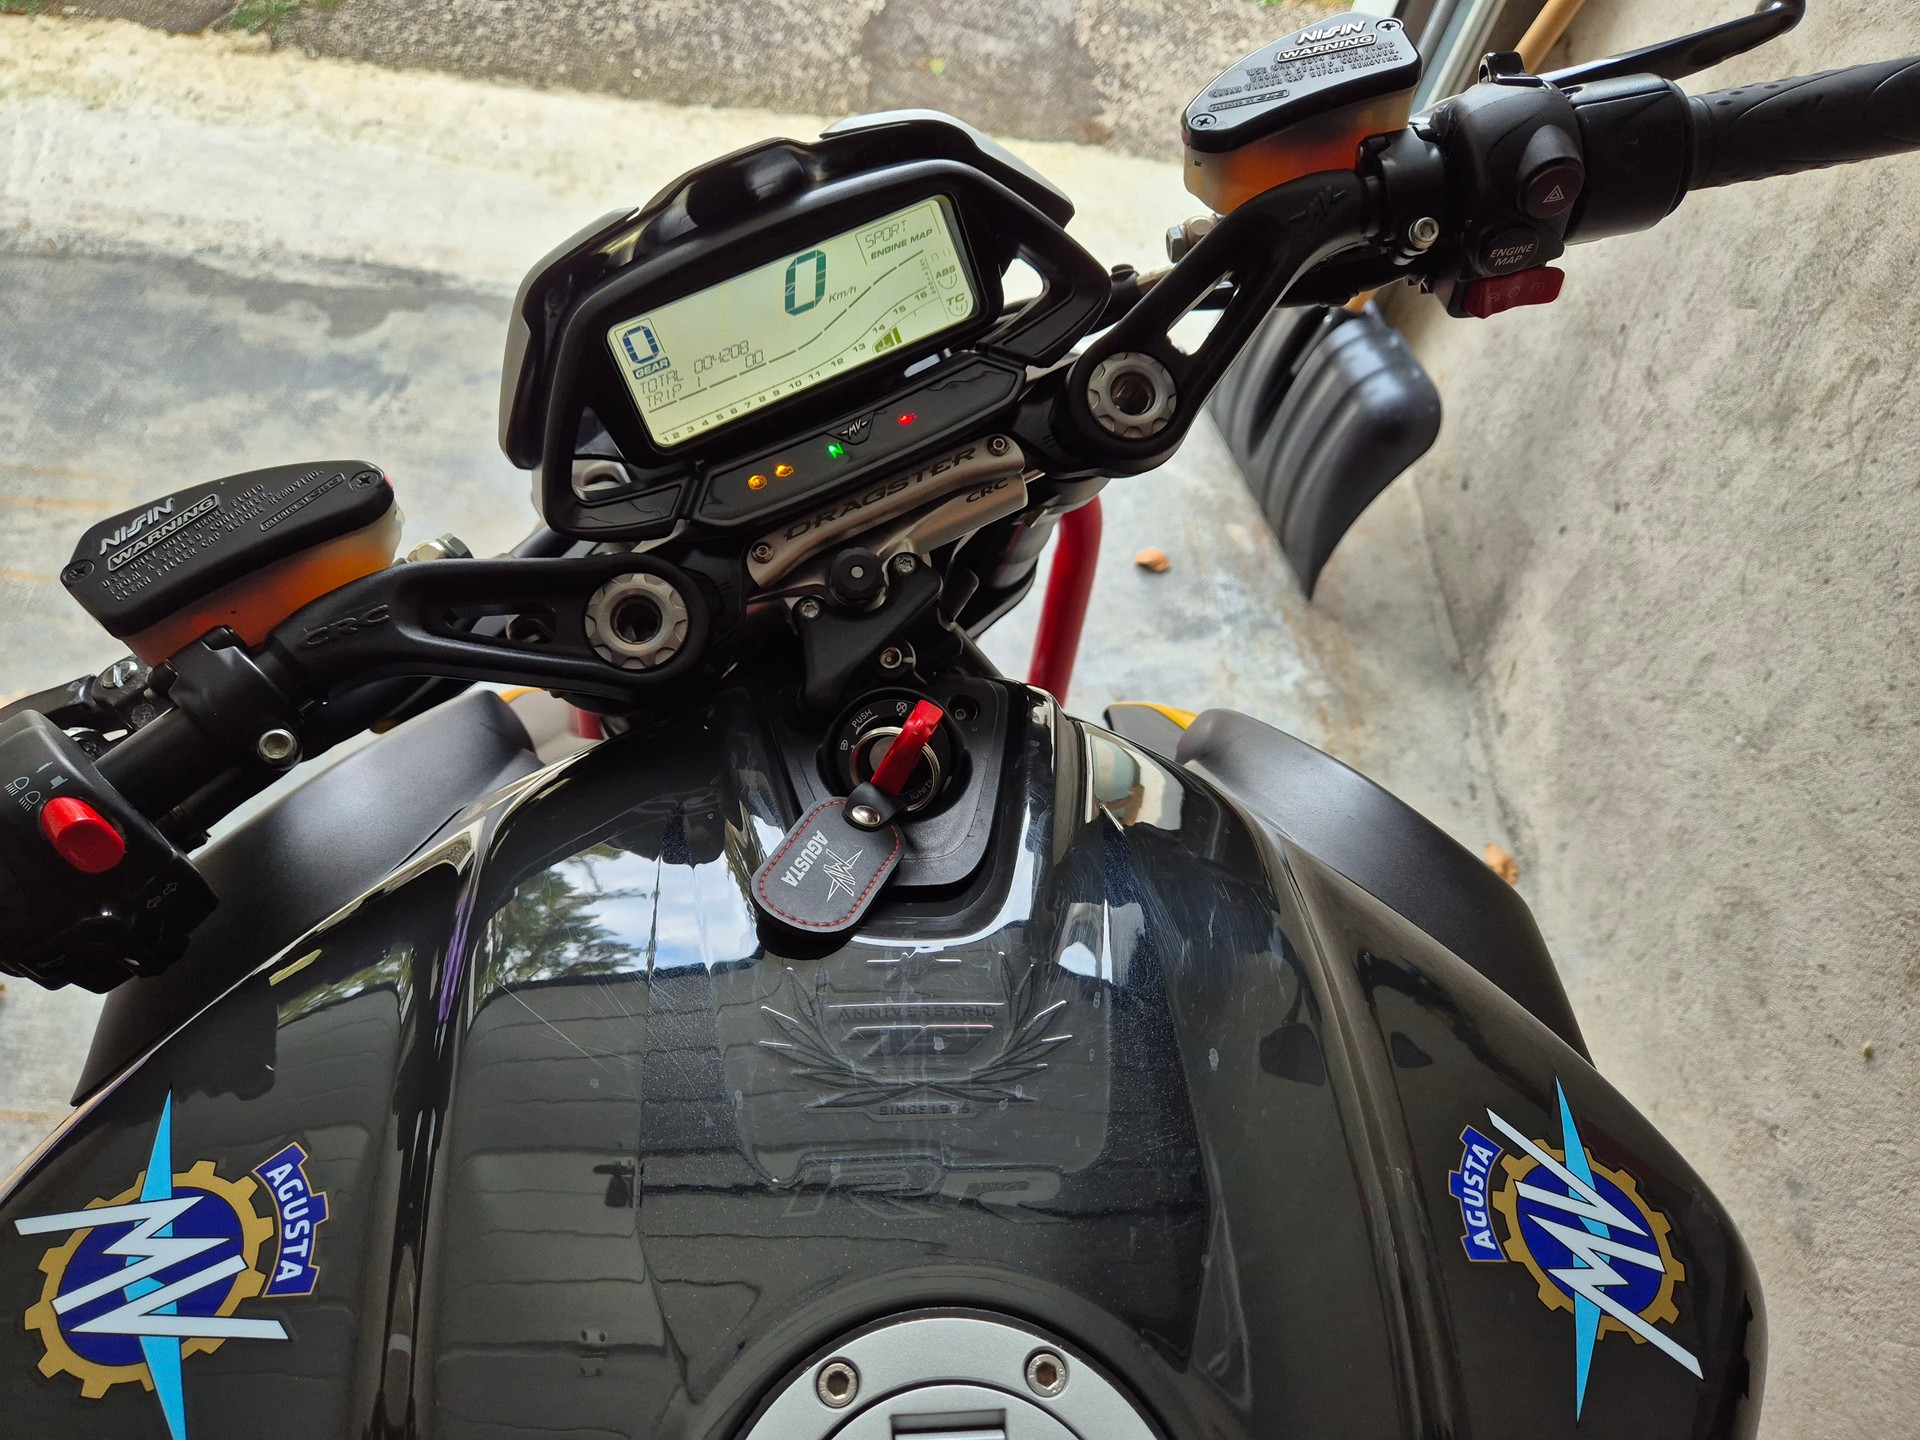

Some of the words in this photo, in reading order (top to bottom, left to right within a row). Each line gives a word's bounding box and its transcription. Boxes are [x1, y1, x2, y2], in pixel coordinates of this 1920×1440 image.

[1281, 35, 1373, 60] WARNING
[865, 220, 907, 249] SPORT
[870, 239, 908, 260] ENGINE
[910, 228, 933, 244] MAP
[1490, 243, 1535, 258] ENGINE
[935, 265, 956, 279] ABS
[1494, 254, 1523, 266] MAP
[785, 249, 826, 316] 0
[829, 285, 857, 304] Km/h
[946, 293, 965, 306] TC
[622, 325, 660, 364] 0
[744, 401, 751, 409] 7
[773, 389, 780, 397] 9
[789, 380, 802, 390] 10
[808, 370, 821, 380] 11
[830, 358, 845, 367] 12
[852, 343, 866, 353] 13
[872, 324, 885, 333] 14
[893, 305, 906, 315] 15
[914, 291, 927, 301] 16
[635, 359, 669, 379] GEAR
[640, 370, 684, 395] TOTAL
[694, 340, 749, 375] 004208
[646, 384, 682, 408] TRIP
[783, 447, 976, 541] DRAGSTER
[965, 478, 1009, 503] CRC
[112, 498, 215, 566] WARNING
[154, 546, 197, 577] FILLER
[225, 504, 265, 532] BEFORE
[108, 571, 142, 595] FROM
[158, 532, 203, 563] SEALED
[303, 603, 390, 648] CRC
[851, 709, 872, 728] PUSH
[781, 830, 829, 887] AGUSTA
[839, 1007, 995, 1019] ANNIVERSARIO
[929, 1104, 970, 1114] 195
[1463, 1143, 1497, 1250] AGUSTA
[265, 1163, 310, 1282] AGUSTA
